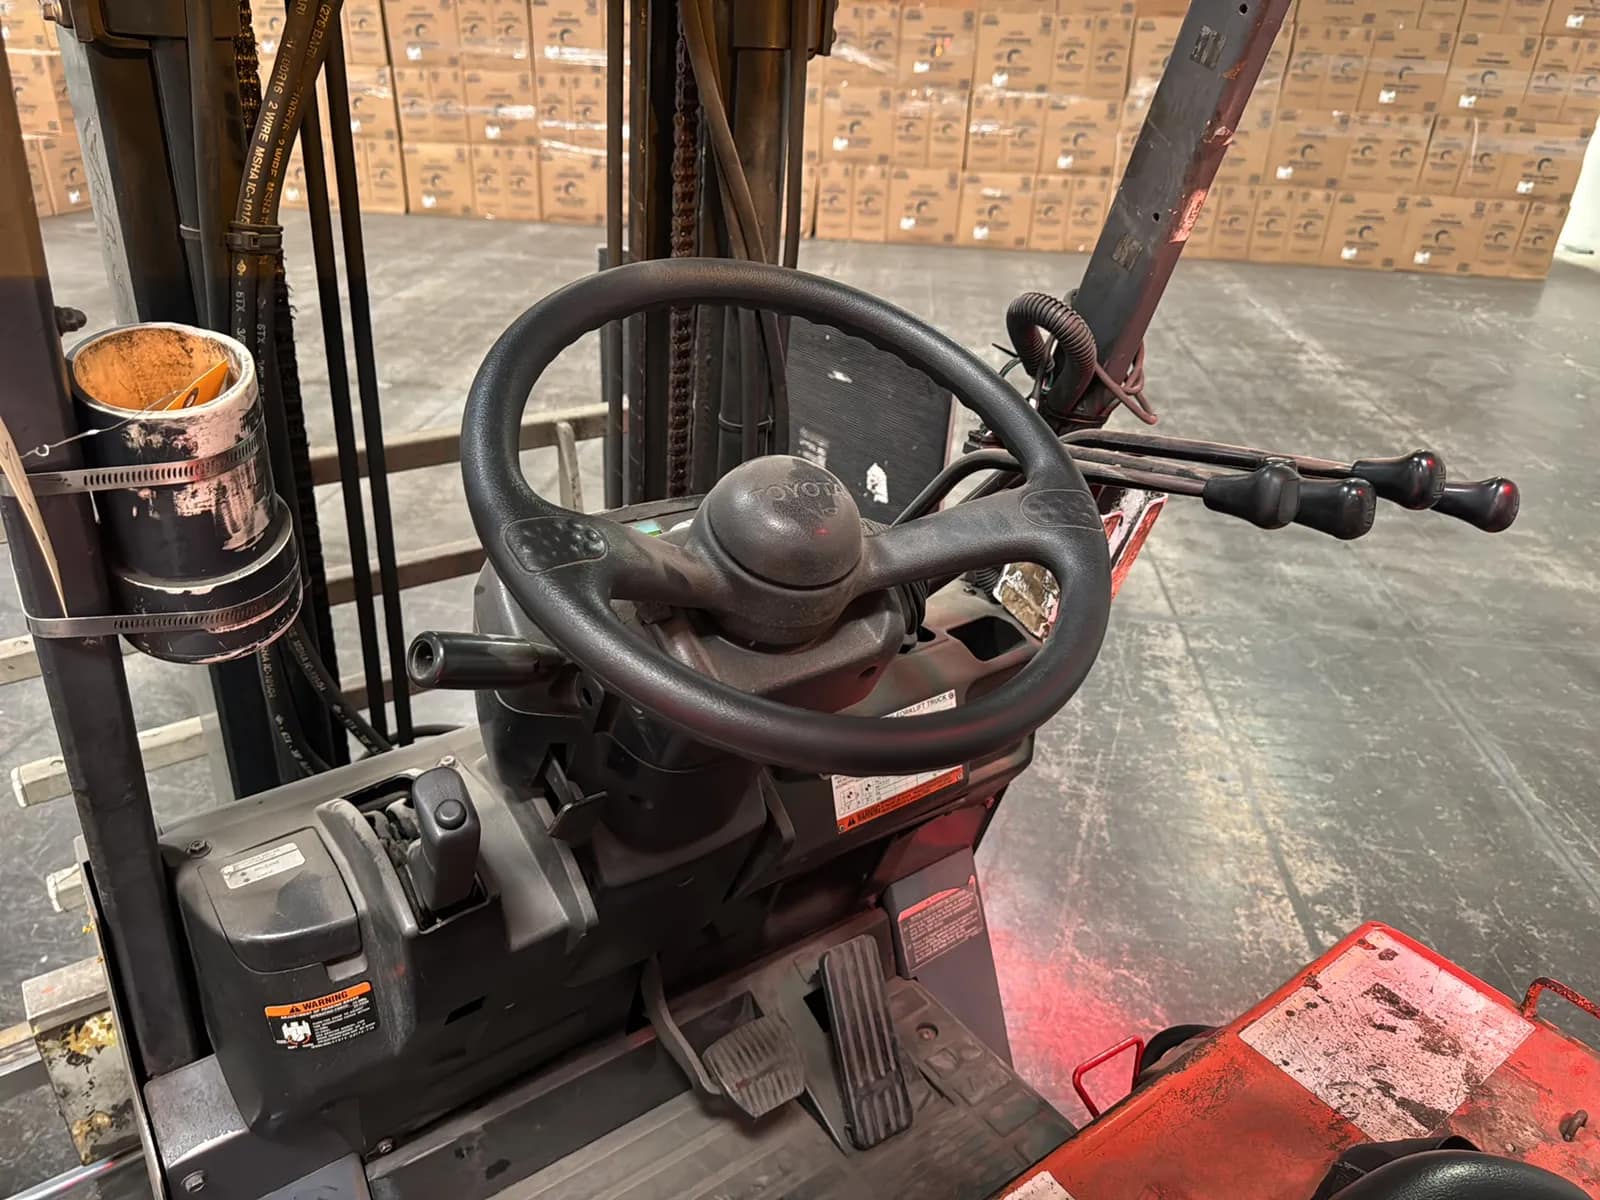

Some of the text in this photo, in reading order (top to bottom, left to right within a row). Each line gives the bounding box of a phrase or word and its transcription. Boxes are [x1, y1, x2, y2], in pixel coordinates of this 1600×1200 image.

[268, 100, 278, 110] 2
[258, 111, 276, 143] WIRE
[248, 145, 266, 180] MSHA
[751, 480, 850, 503] TOYOTA
[926, 693, 948, 708] TRUCK
[302, 990, 348, 1011] WARNING
